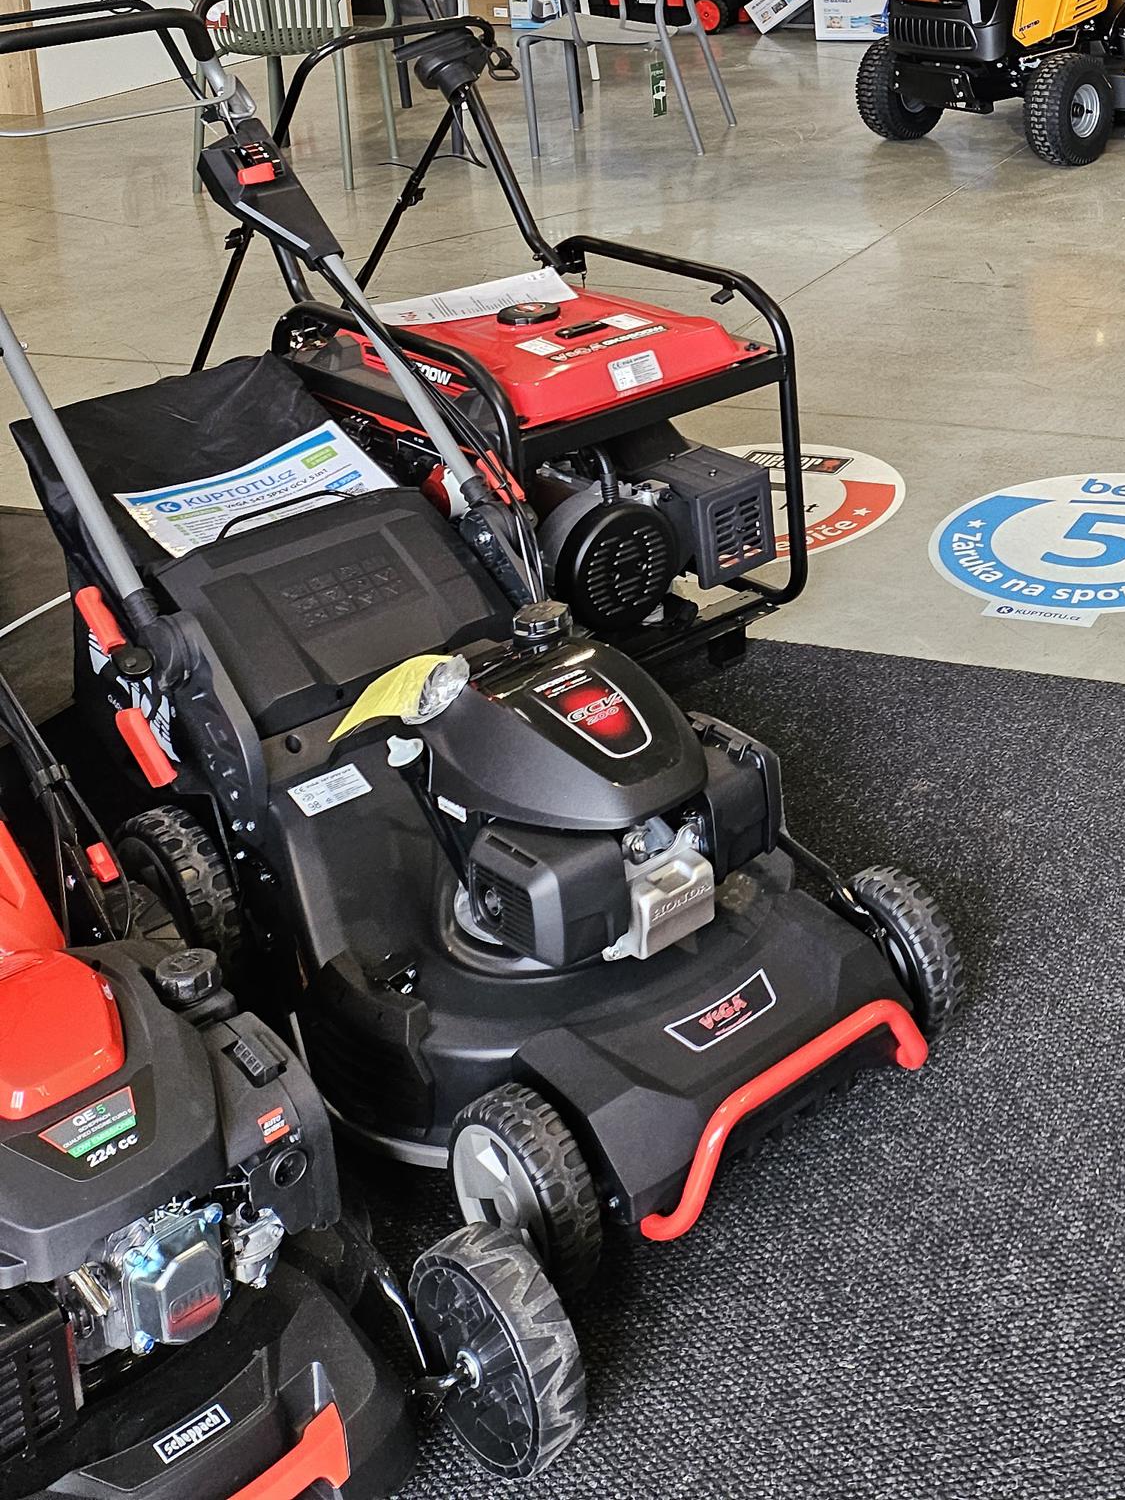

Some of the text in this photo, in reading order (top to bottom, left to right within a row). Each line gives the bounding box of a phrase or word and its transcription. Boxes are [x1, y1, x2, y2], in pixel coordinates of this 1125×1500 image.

[184, 469, 297, 507] KUPTOTU.cz
[952, 531, 1004, 583] Záruka
[1001, 577, 1045, 597] na
[1014, 608, 1081, 621] KUPTOTU.cz
[651, 883, 713, 923] HONDA
[698, 993, 748, 1031] VeGA
[72, 1104, 106, 1127] QE 5
[263, 1114, 282, 1129] AUTO
[86, 1133, 139, 1168] 224 cc
[163, 1411, 222, 1457] scheppach
